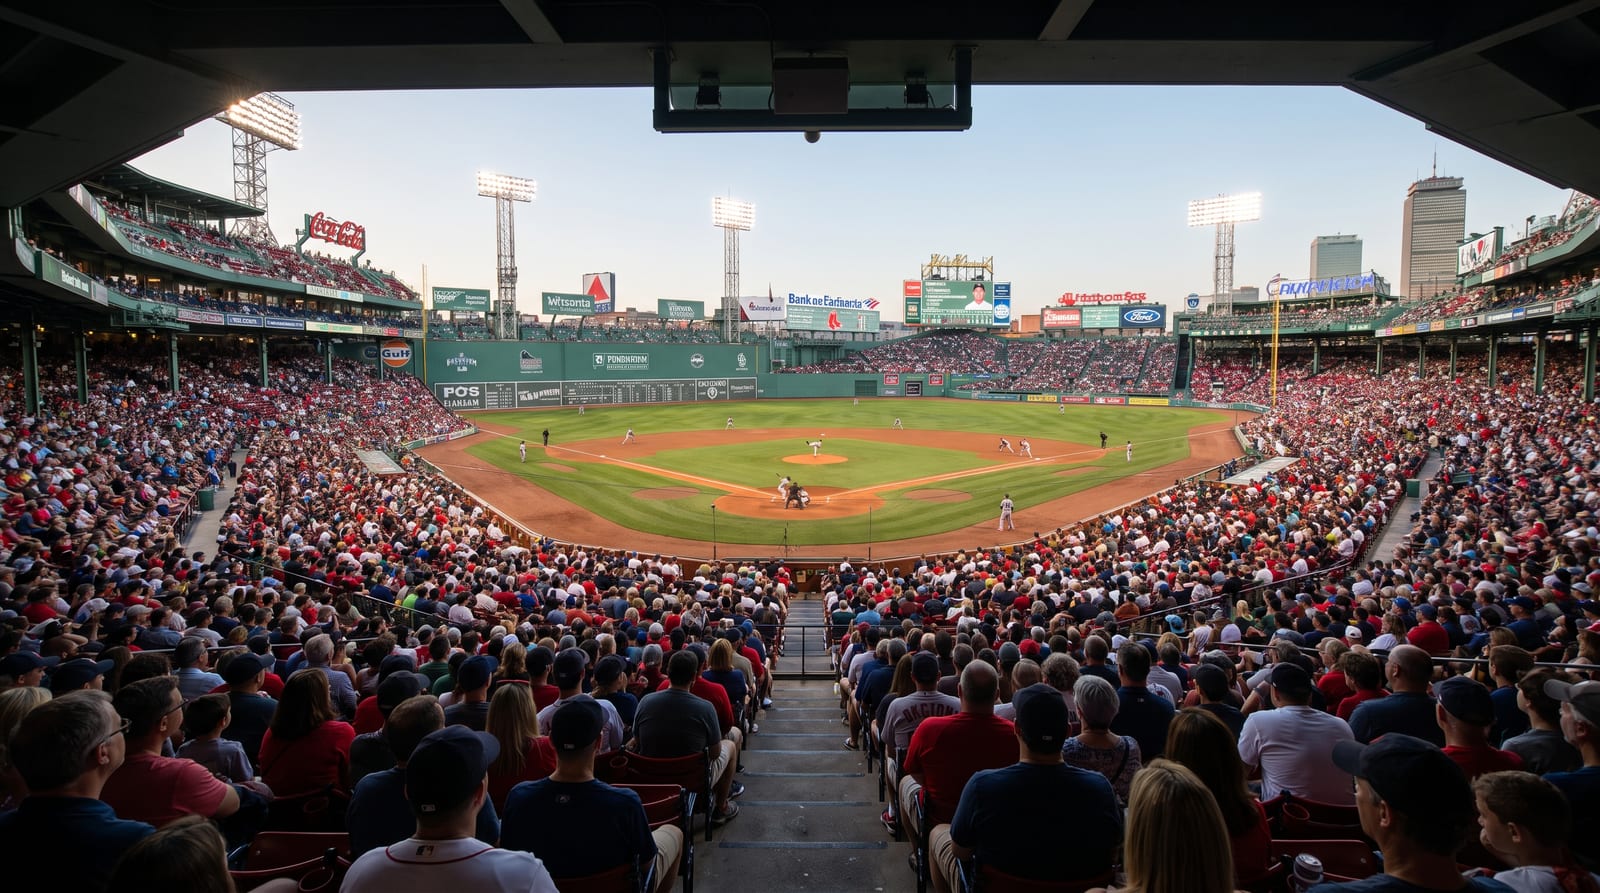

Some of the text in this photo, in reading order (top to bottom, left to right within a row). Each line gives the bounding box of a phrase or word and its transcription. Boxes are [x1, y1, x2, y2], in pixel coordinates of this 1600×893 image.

[788, 293, 813, 305] Bank
[1130, 311, 1153, 321] Ford
[443, 386, 480, 398] POS
